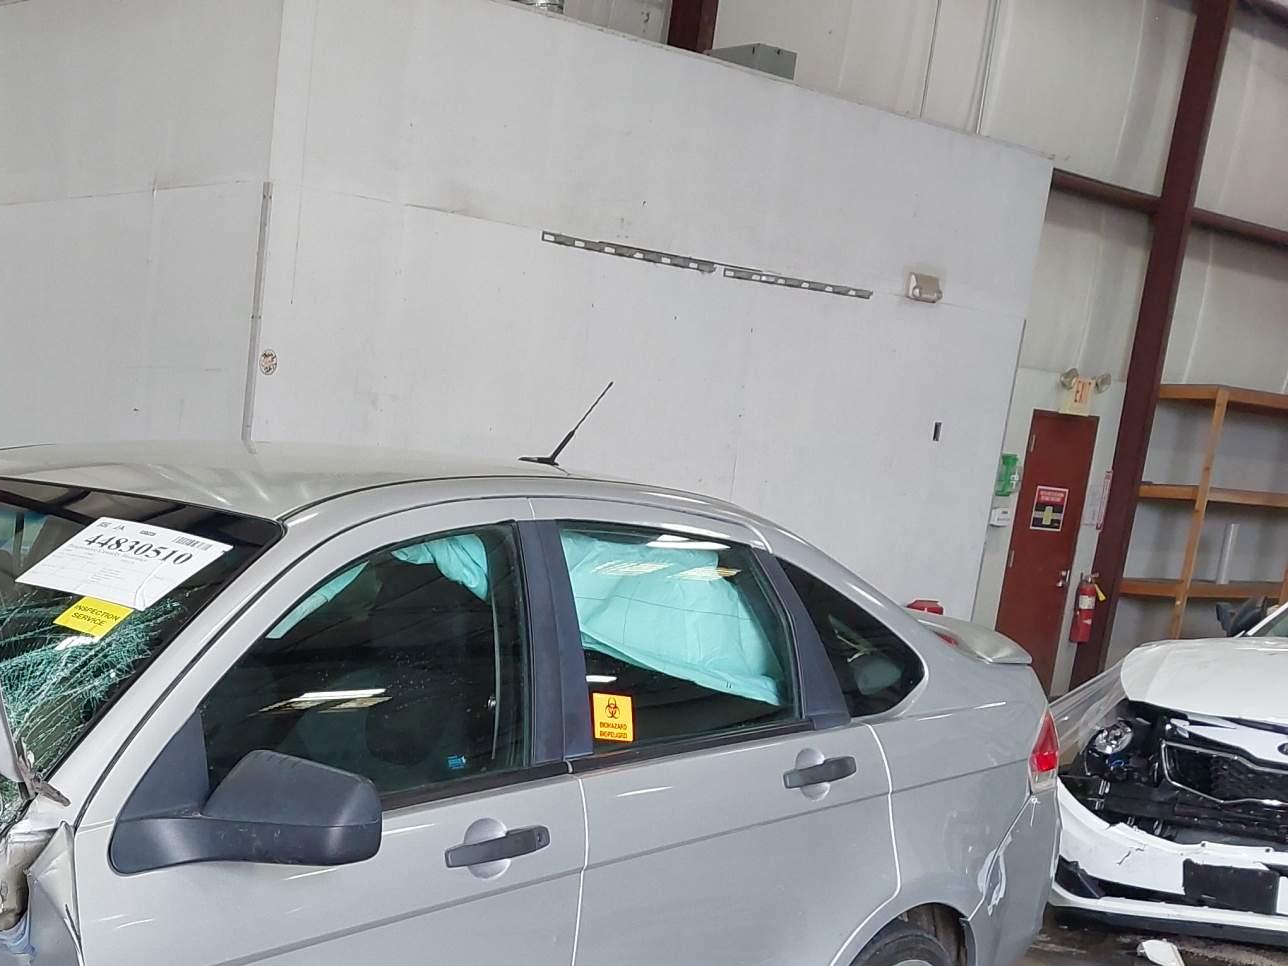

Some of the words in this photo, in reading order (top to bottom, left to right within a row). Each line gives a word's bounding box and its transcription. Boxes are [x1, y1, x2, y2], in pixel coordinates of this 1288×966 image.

[84, 534, 193, 565] 44830510
[71, 612, 106, 626] SERVICE
[75, 605, 120, 621] INSPECTION
